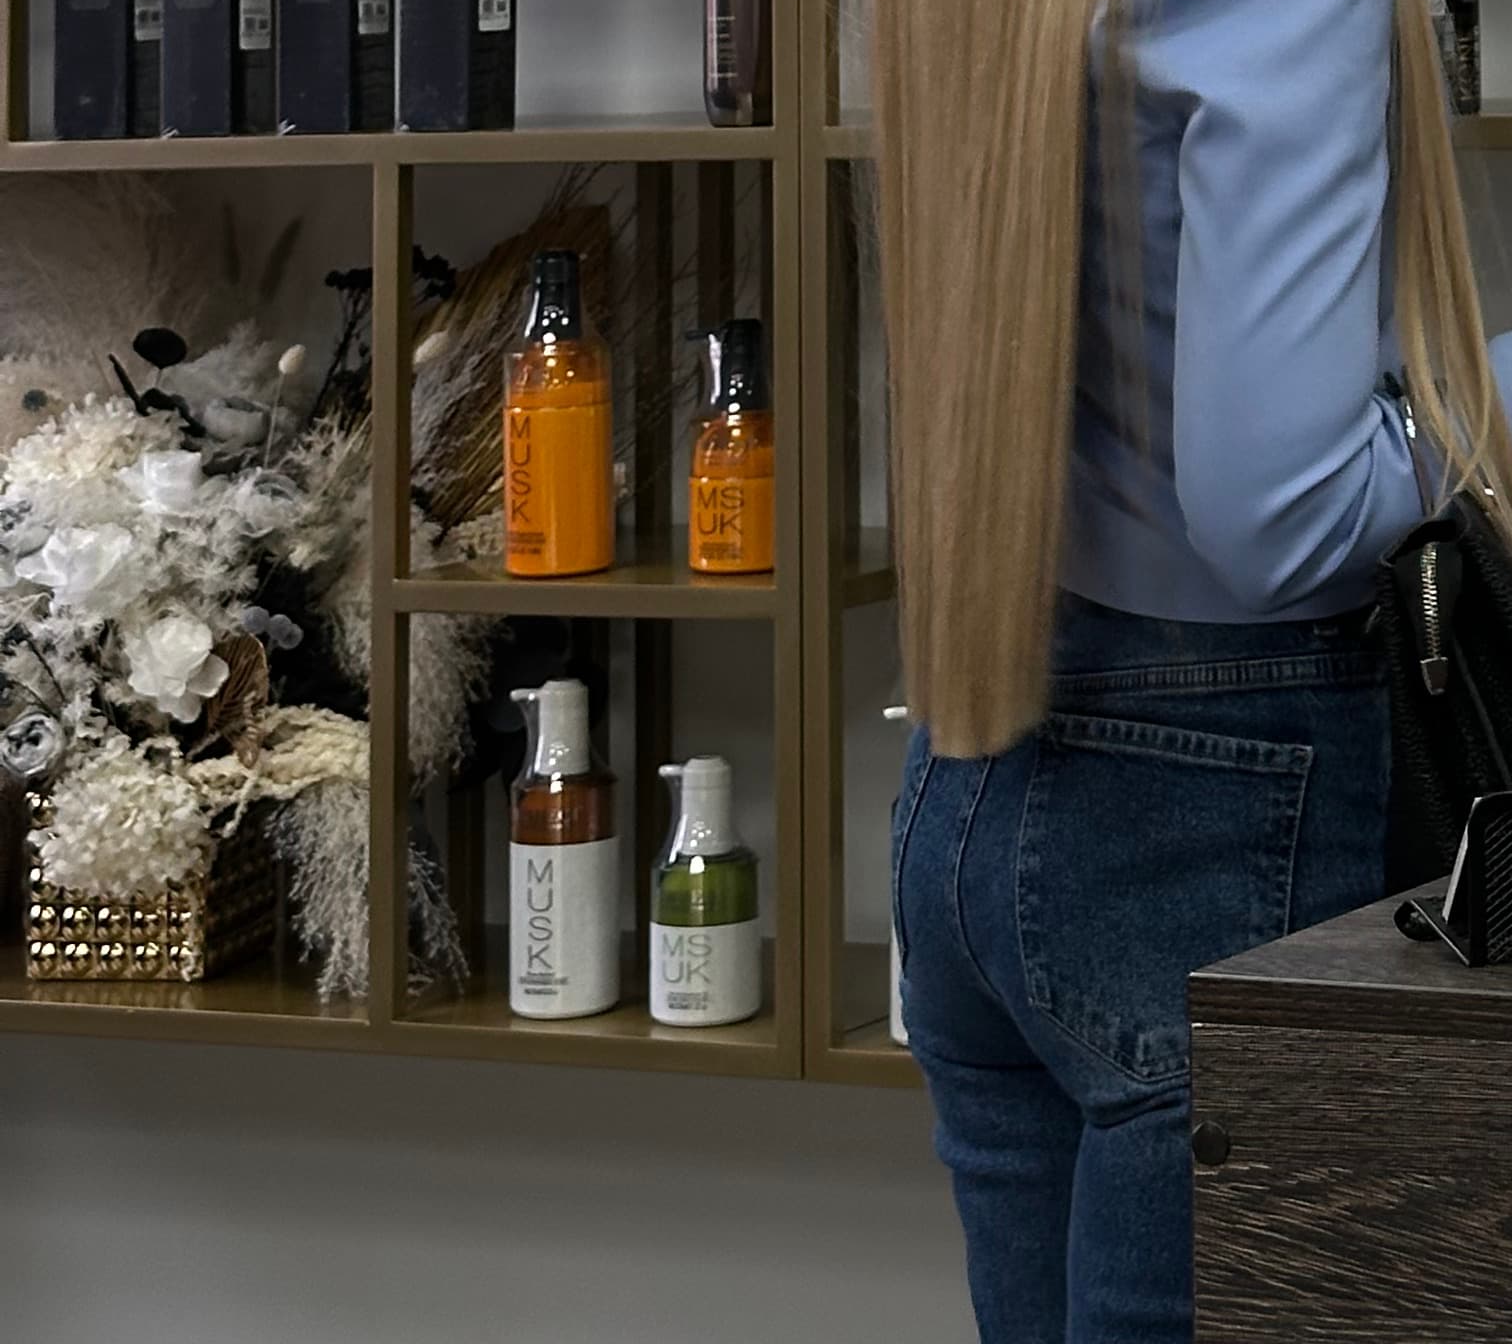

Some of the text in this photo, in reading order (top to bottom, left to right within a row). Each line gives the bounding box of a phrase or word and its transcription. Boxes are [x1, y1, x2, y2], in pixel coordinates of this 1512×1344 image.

[510, 418, 531, 523] MUSK
[699, 486, 745, 509] MS
[526, 858, 554, 970] MUSK
[661, 933, 712, 959] MS
[661, 959, 712, 985] UK
